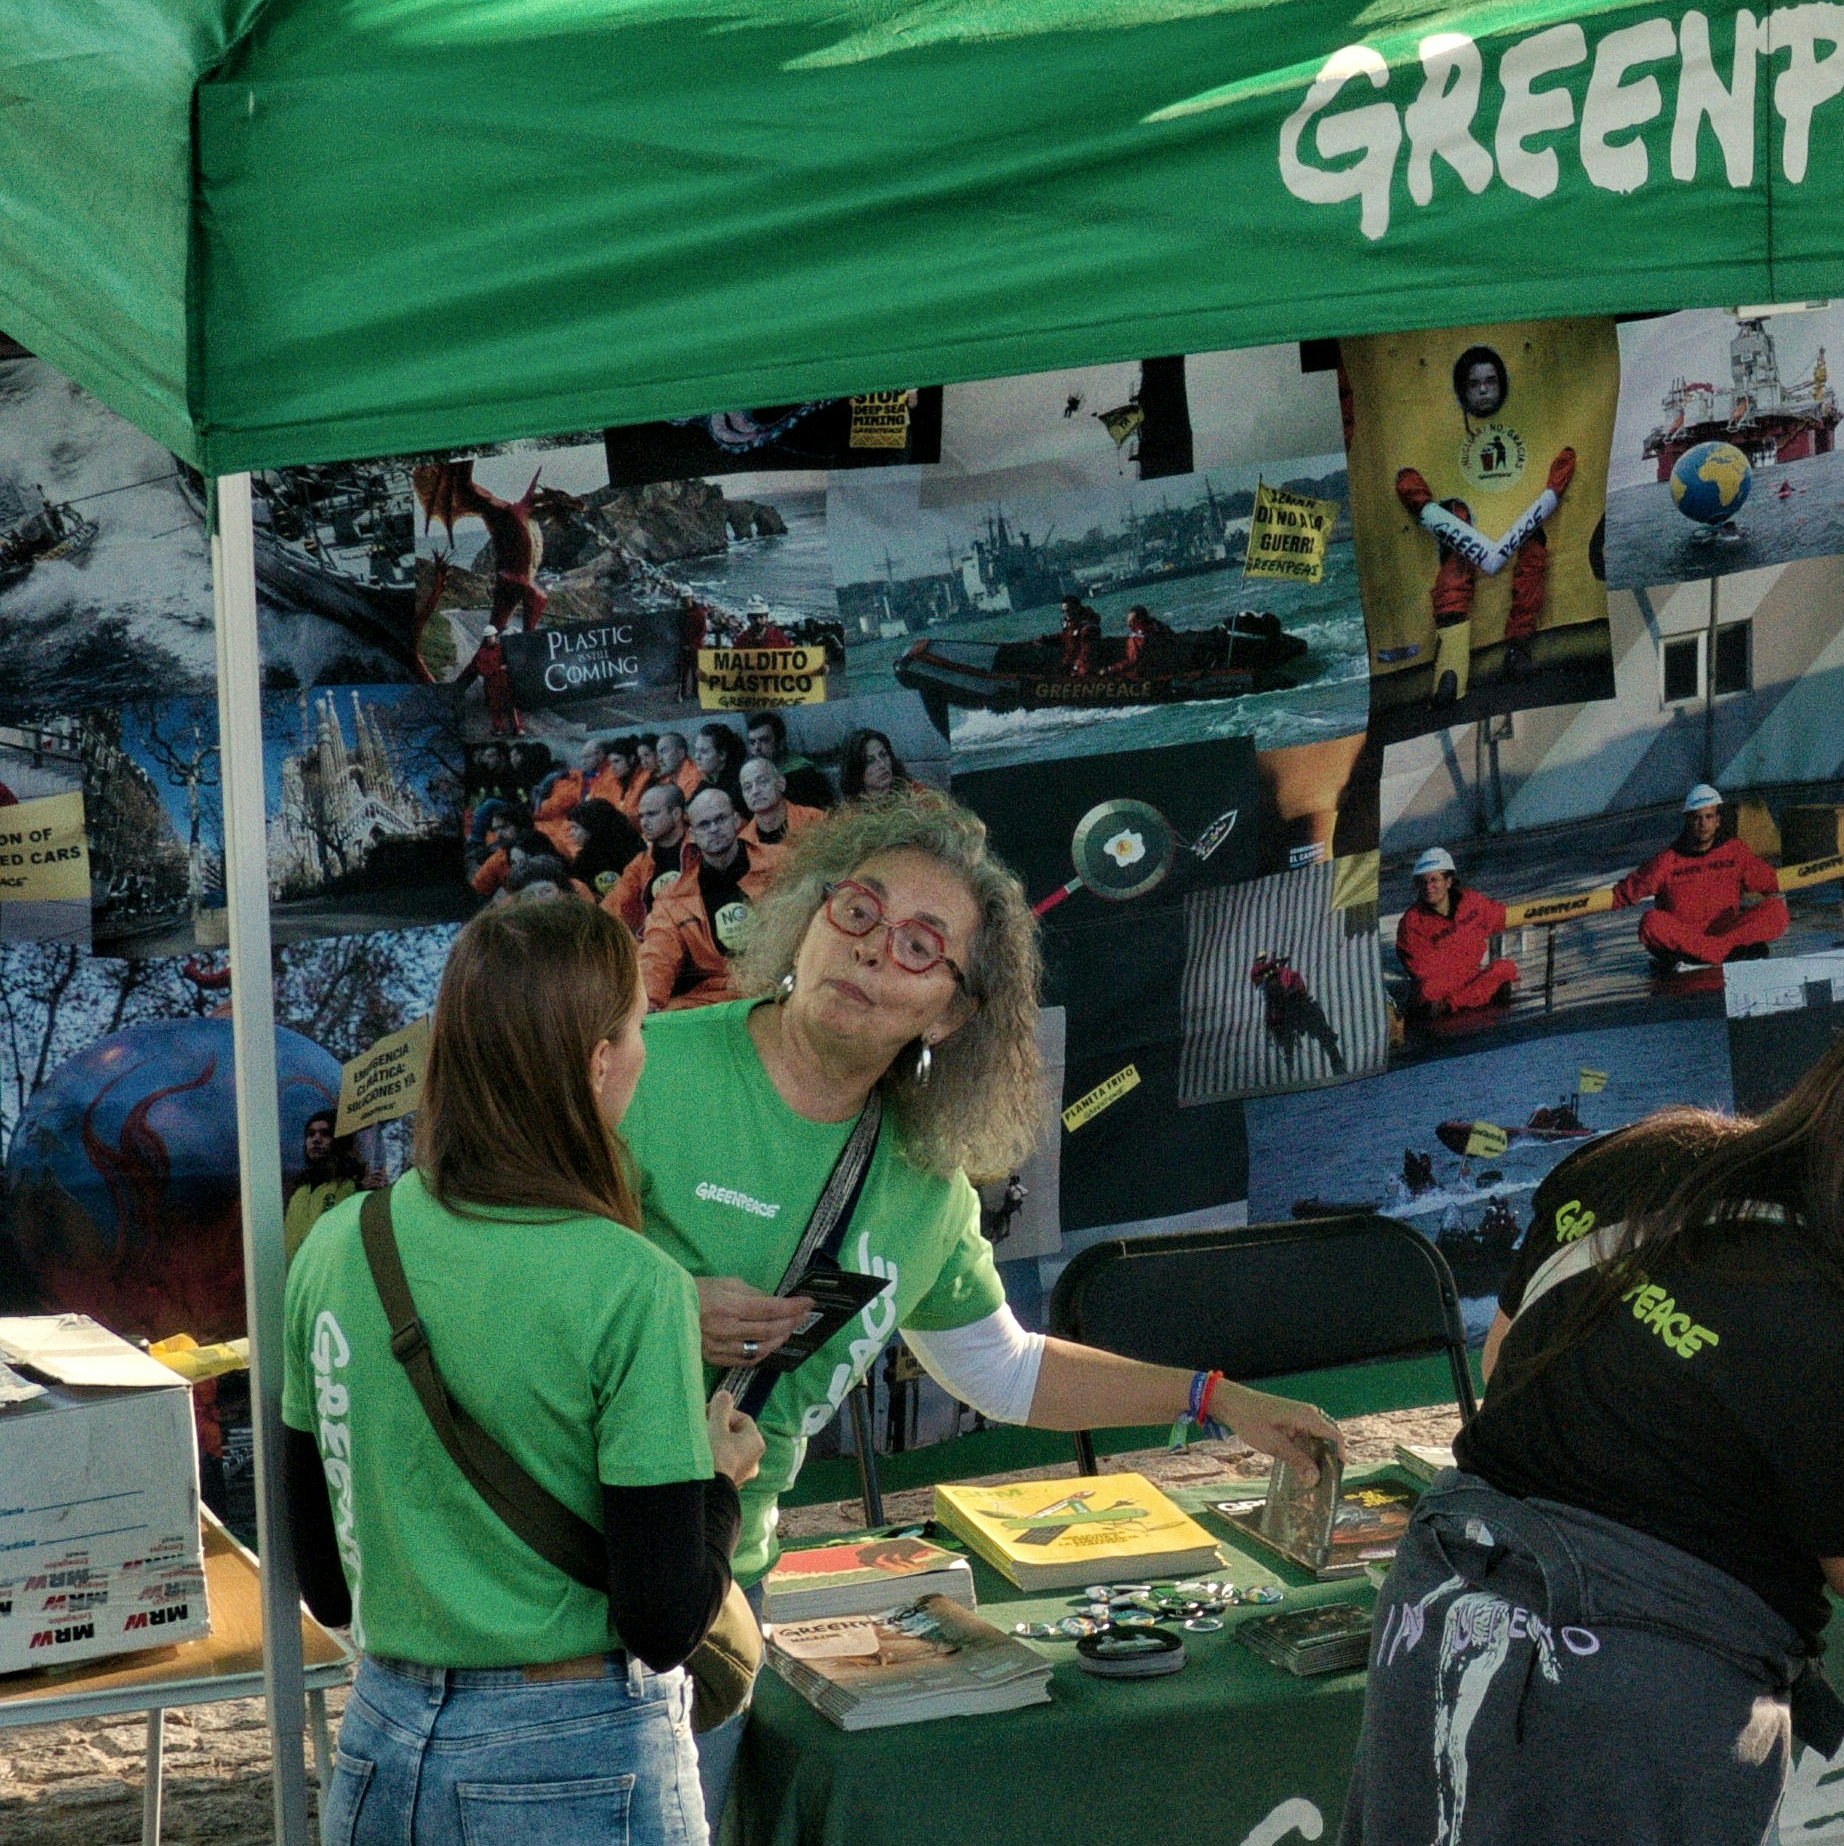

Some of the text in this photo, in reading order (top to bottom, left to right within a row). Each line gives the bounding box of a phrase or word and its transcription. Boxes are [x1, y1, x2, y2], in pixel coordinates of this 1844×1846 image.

[1433, 522, 1488, 565] GREEN
[547, 625, 633, 660] PLASTIC
[544, 655, 639, 692] COMING
[714, 650, 808, 671] MALDITO
[1035, 681, 1152, 698] GREENPEACE
[29, 827, 53, 843] OF
[31, 845, 81, 865] CARS
[1106, 1067, 1134, 1090] FRITO
[695, 1181, 781, 1219] GREENPEACE
[123, 1604, 189, 1632] MRW
[29, 1622, 95, 1649] MRW
